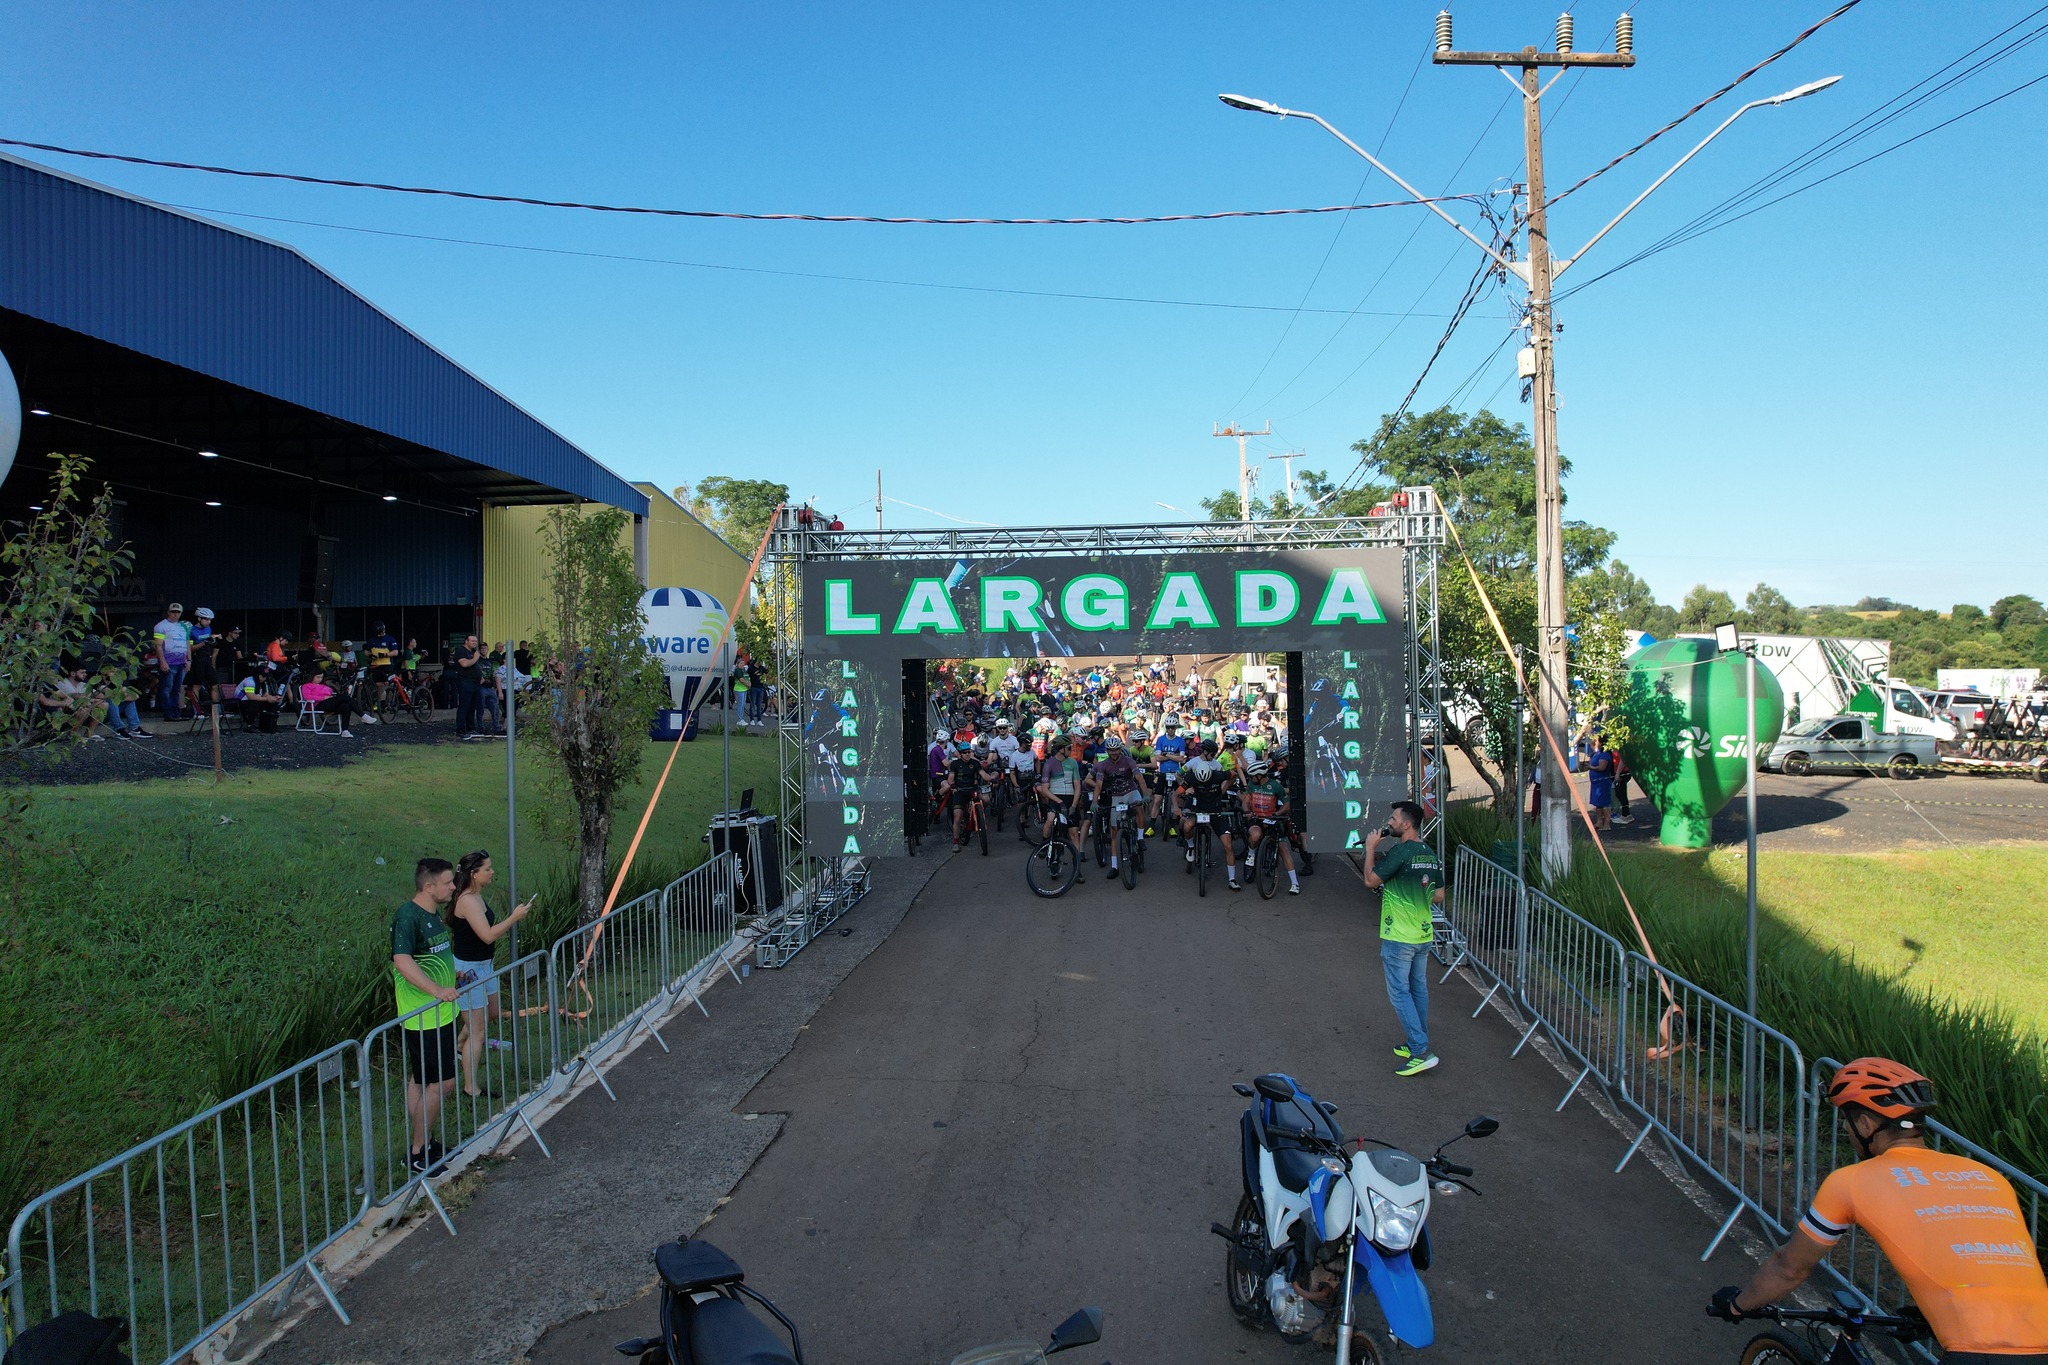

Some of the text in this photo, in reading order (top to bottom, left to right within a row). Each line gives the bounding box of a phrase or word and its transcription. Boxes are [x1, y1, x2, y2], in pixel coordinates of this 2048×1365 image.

[825, 567, 1388, 635] LARGADA
[1761, 644, 1792, 658] DW
[842, 660, 861, 854] LARGADA
[1342, 651, 1364, 849] LARGADA
[1932, 1170, 1994, 1183] COPEL
